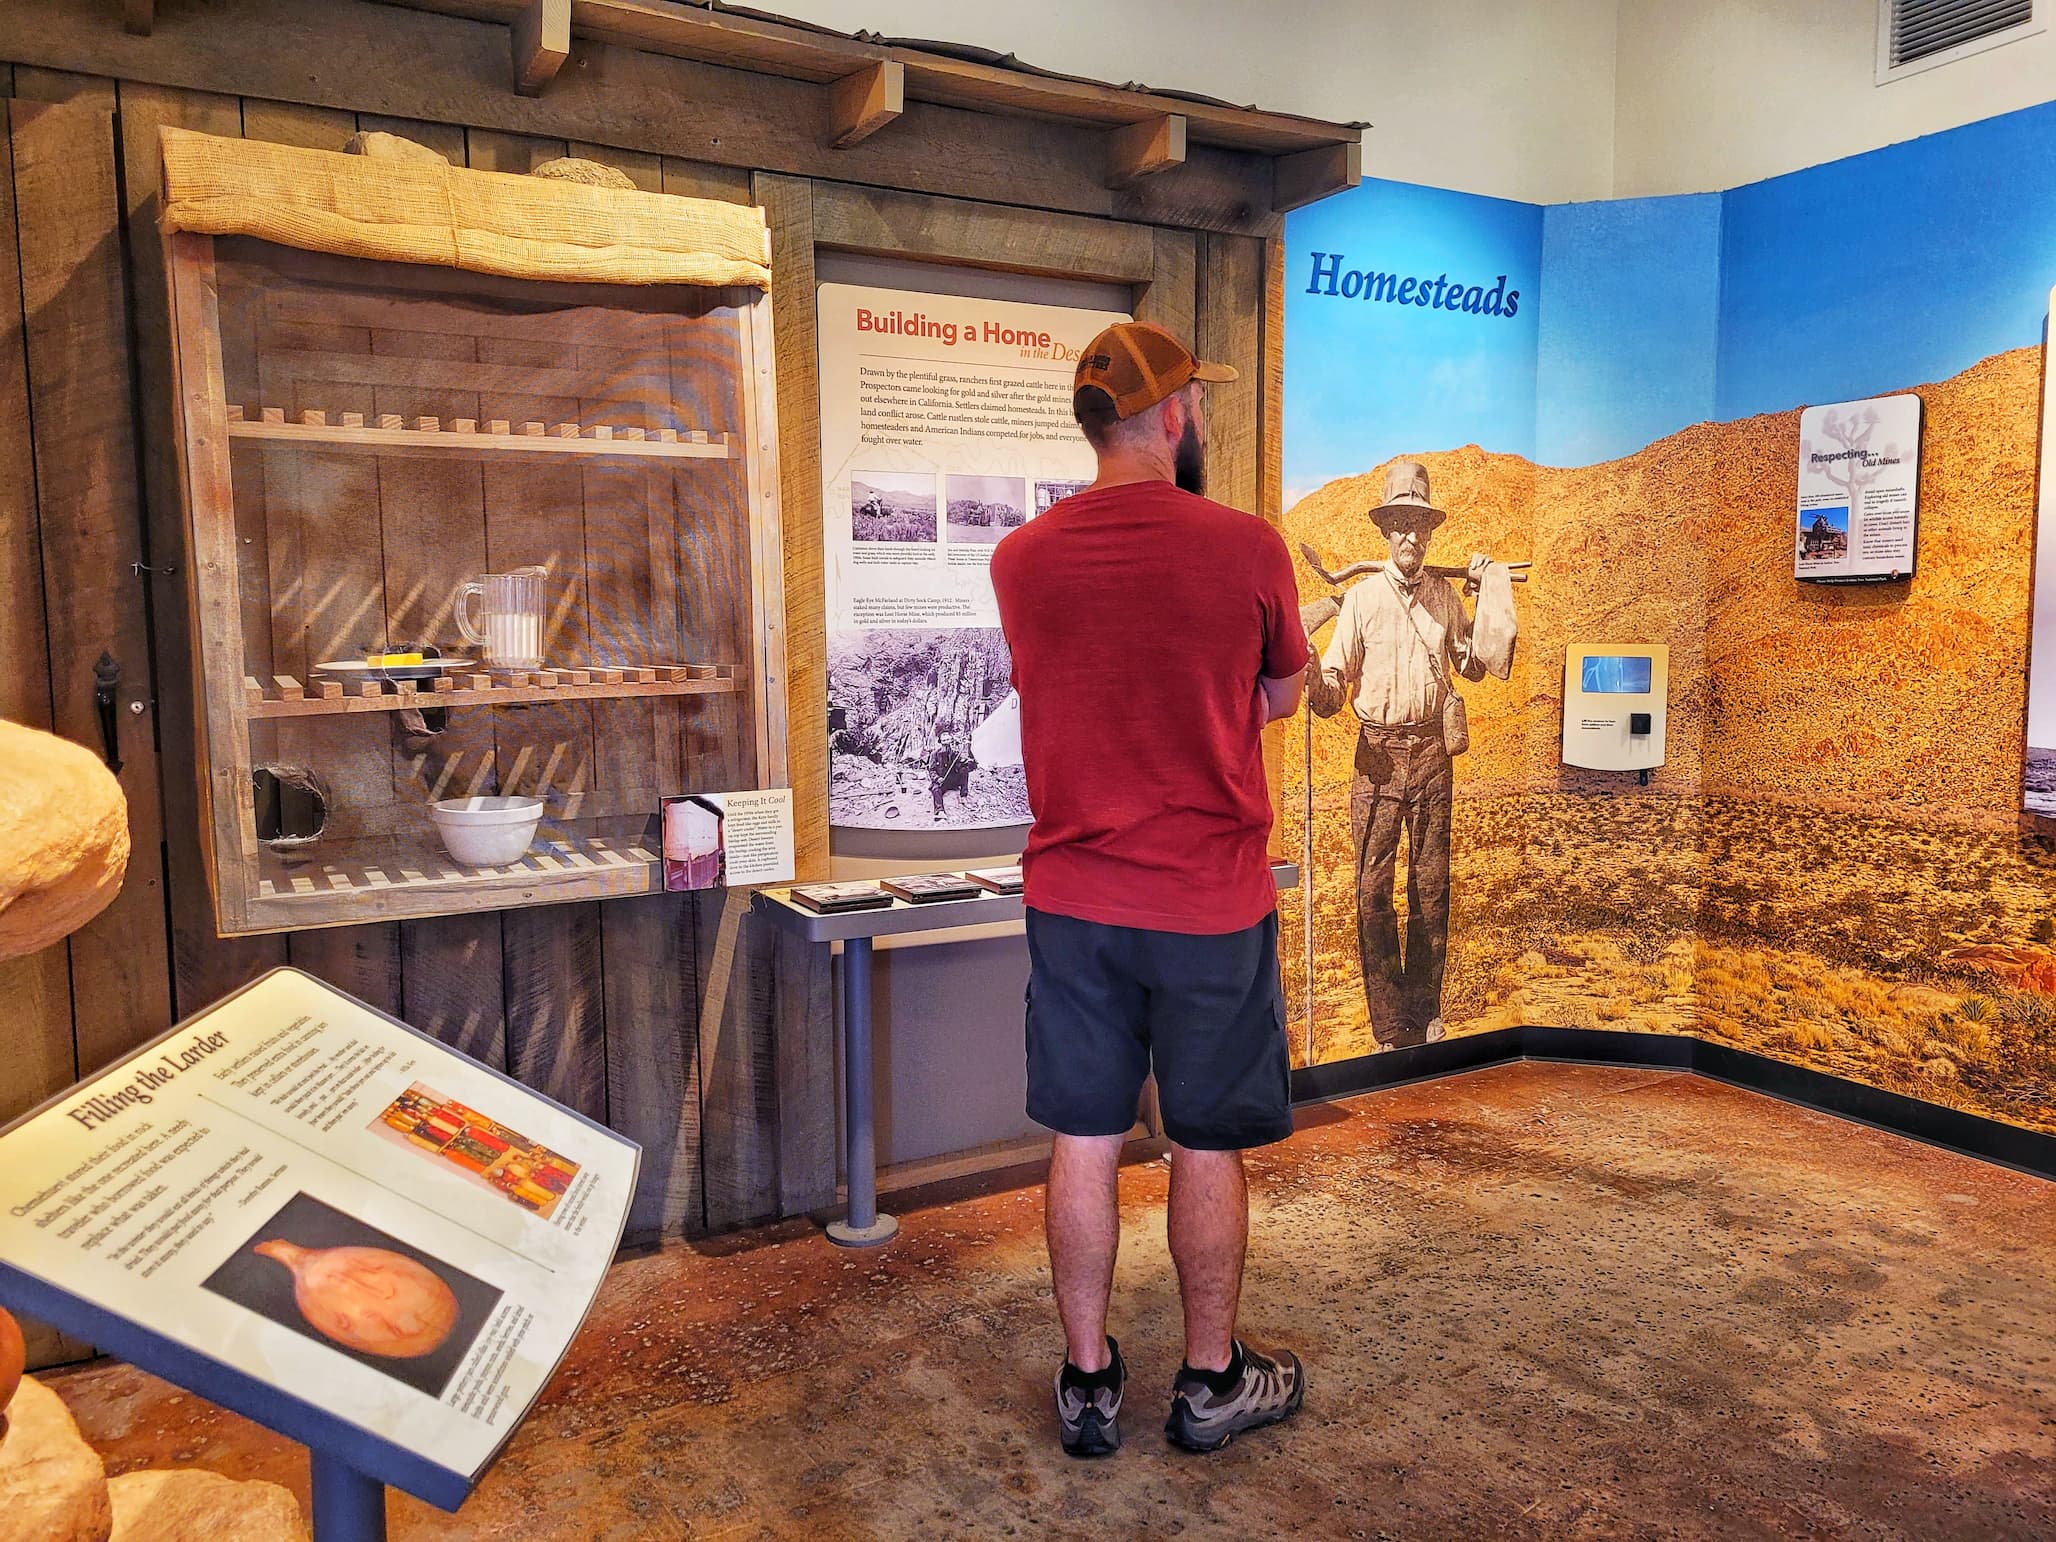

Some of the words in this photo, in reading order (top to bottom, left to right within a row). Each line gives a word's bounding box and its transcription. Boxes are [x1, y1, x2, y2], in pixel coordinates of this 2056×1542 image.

[1306, 251, 1520, 318] Homesteads
[857, 308, 957, 346] Building
[963, 325, 977, 342] a
[983, 321, 1051, 348] Home
[1020, 346, 1031, 358] in
[1033, 347, 1049, 359] the
[1051, 342, 1080, 361] Des
[860, 368, 884, 377] Drawn
[887, 370, 894, 381] by
[896, 371, 907, 379] the
[909, 372, 938, 382] plentiful
[939, 376, 958, 384] grass,
[960, 377, 988, 385] ranchers
[990, 378, 1002, 386] first
[1004, 380, 1024, 389] grazed
[1026, 381, 1042, 389] cattle
[1044, 382, 1057, 390] here
[1059, 383, 1065, 391] in
[860, 382, 901, 393] Prospectors
[922, 386, 948, 398] looking
[950, 388, 960, 396] for
[961, 389, 975, 399] gold
[977, 390, 989, 398] and
[991, 391, 1008, 399] silver
[1010, 392, 1024, 400] after
[1026, 393, 1036, 401] the
[1037, 394, 1051, 404] gold
[1053, 396, 1072, 404] mines
[874, 396, 908, 406] elsewhere
[918, 399, 953, 409] California.
[956, 402, 979, 411] Settlers
[981, 404, 1006, 412] claimed
[1008, 405, 1046, 415] homesteads.
[1049, 408, 1055, 416] In
[1057, 408, 1068, 417] this
[861, 409, 876, 417] land
[878, 411, 904, 419] conflict
[927, 413, 947, 421] Cattle
[949, 415, 973, 423] rustlers
[975, 416, 989, 424] stole
[991, 417, 1010, 426] cattle,
[1011, 418, 1032, 426] miners
[1034, 420, 1058, 430] jumped
[1060, 421, 1079, 429] claim
[861, 422, 908, 432] homesteaders
[925, 426, 959, 435] American
[960, 428, 984, 437] Indians
[986, 430, 1018, 440] competed
[1020, 431, 1029, 439] for
[1030, 432, 1044, 442] jobs,
[1046, 433, 1058, 441] and
[861, 436, 884, 446] fought
[903, 438, 922, 446] water.
[1862, 459, 1876, 468] Old
[1877, 457, 1900, 466] Mines
[727, 798, 759, 808] Keeping
[760, 797, 767, 805] It
[769, 795, 786, 804] Cool
[67, 1085, 153, 1131] Filling
[135, 1066, 174, 1091] the
[160, 1031, 230, 1073] Larder
